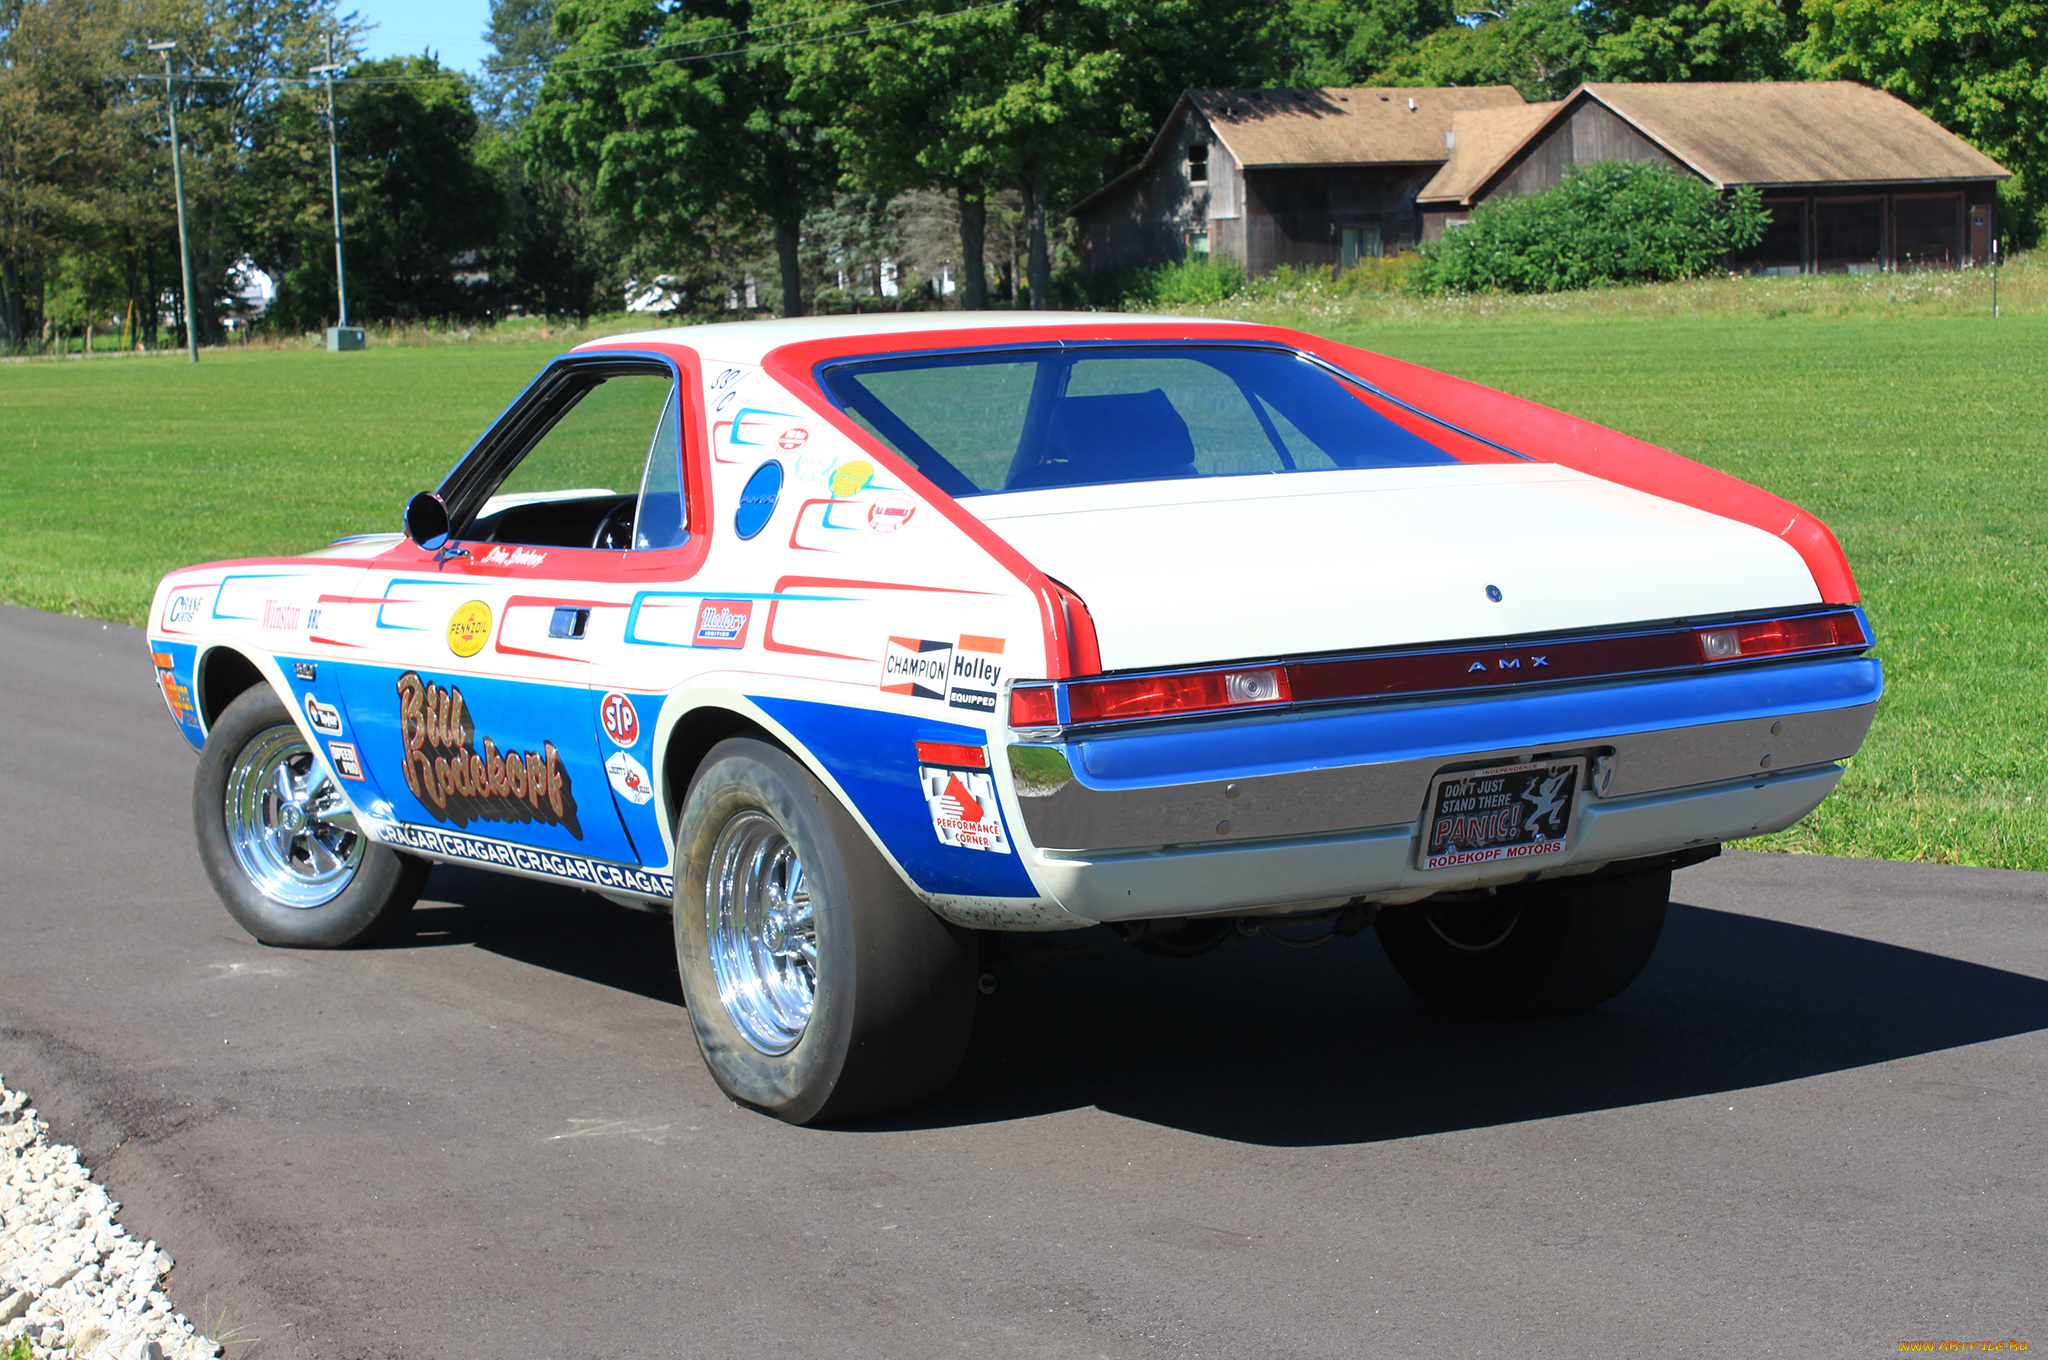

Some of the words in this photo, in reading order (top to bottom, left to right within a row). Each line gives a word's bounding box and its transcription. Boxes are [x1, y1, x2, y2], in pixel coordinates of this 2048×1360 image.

[262, 599, 301, 630] Winston
[702, 607, 747, 630] Mallory
[450, 621, 488, 635] PENNZOIL
[887, 655, 946, 680] CHAMPION
[953, 655, 1002, 687] Holley
[1467, 656, 1549, 672] AMX
[950, 692, 995, 707] EQUIPPED
[318, 710, 338, 727] Taylor
[398, 672, 466, 750] Bill
[606, 696, 634, 737] STP
[331, 746, 357, 762] SPEED
[342, 760, 361, 776] PRO
[402, 735, 564, 818] Rodekopf
[1482, 763, 1538, 775] INDEPENDENCE
[1445, 781, 1476, 799] DON'T
[1477, 779, 1505, 795] JUST
[1442, 797, 1476, 814] STAND
[1479, 793, 1512, 809] THERE
[937, 817, 999, 835] PERFORMANCE
[1434, 805, 1521, 846] PANIC!
[955, 833, 990, 846] CORNER
[378, 826, 439, 851] CRAGAR
[444, 835, 512, 865] CRAGAR
[515, 849, 592, 880] CRAGAR
[1429, 849, 1502, 868] RODEKOPF
[1506, 842, 1561, 857] MOTORS
